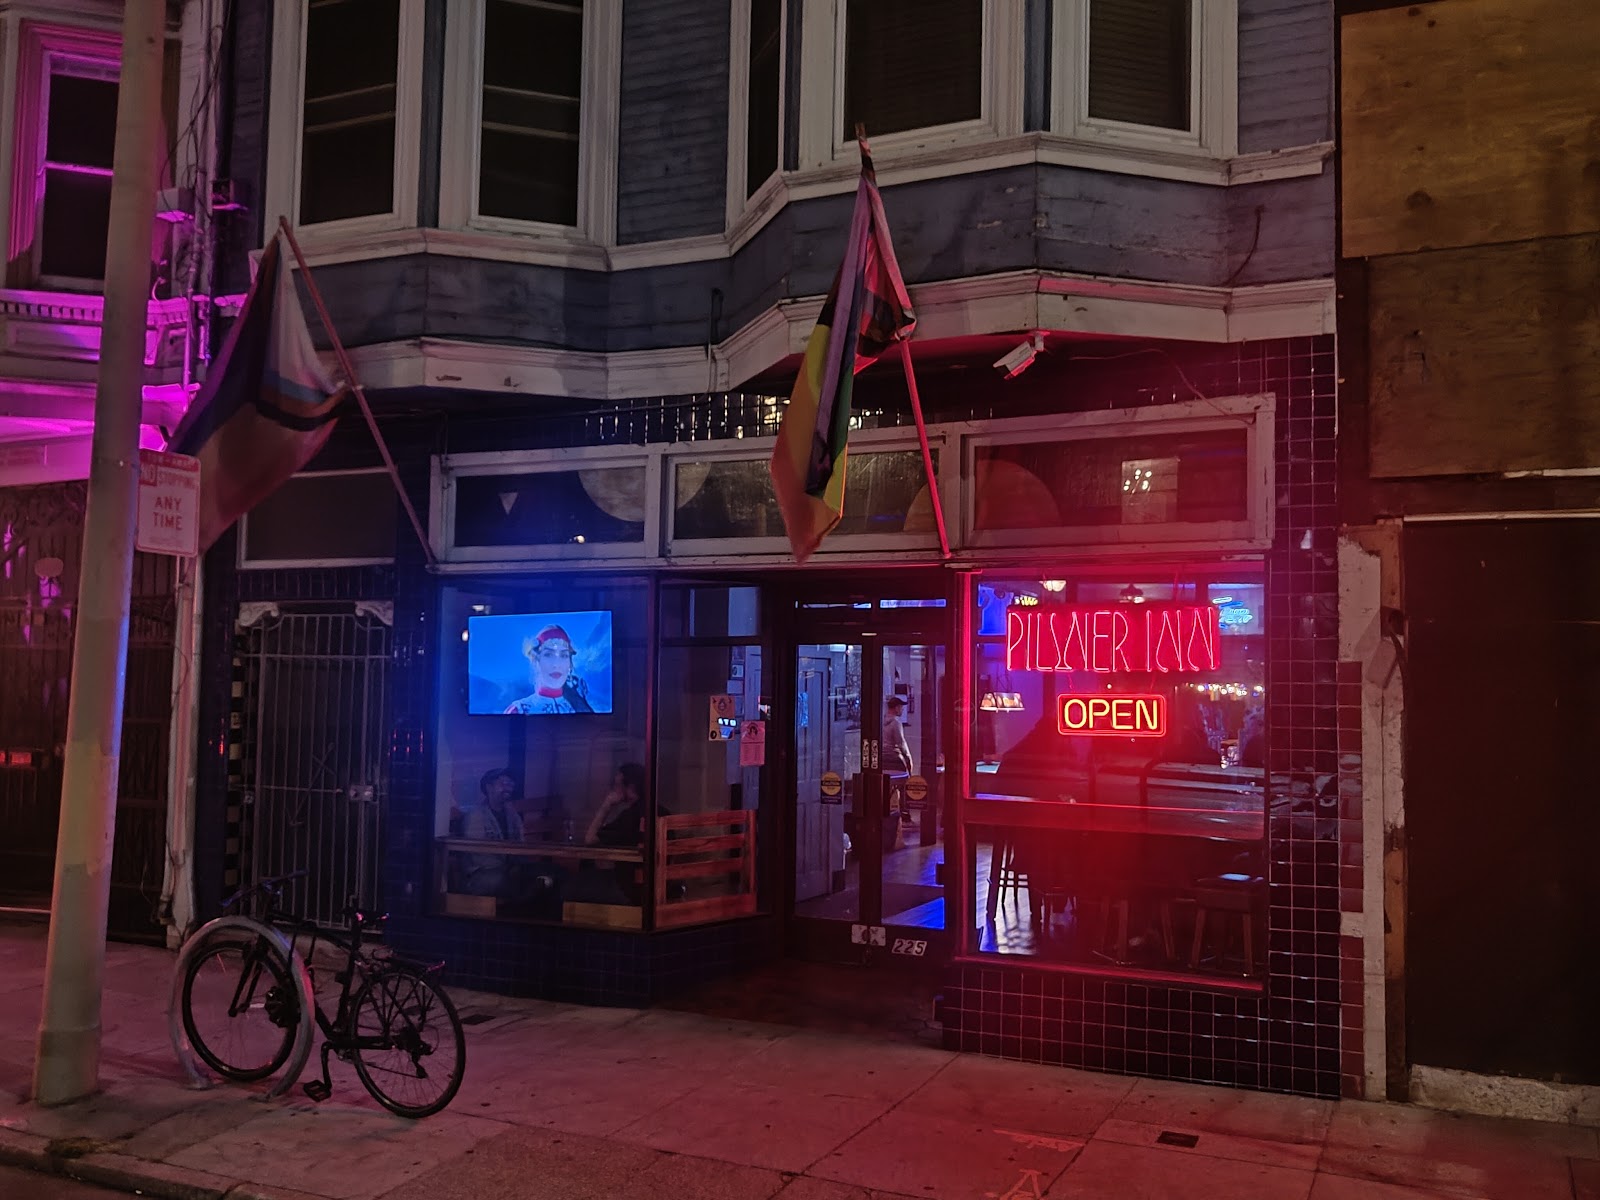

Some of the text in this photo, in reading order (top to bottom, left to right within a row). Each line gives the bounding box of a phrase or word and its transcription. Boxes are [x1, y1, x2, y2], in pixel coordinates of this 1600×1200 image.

[154, 496, 182, 511] ANY
[153, 512, 182, 531] TIME
[1006, 606, 1218, 673] PILSNER INN
[1064, 698, 1158, 730] OPEN
[893, 939, 926, 956] 225
